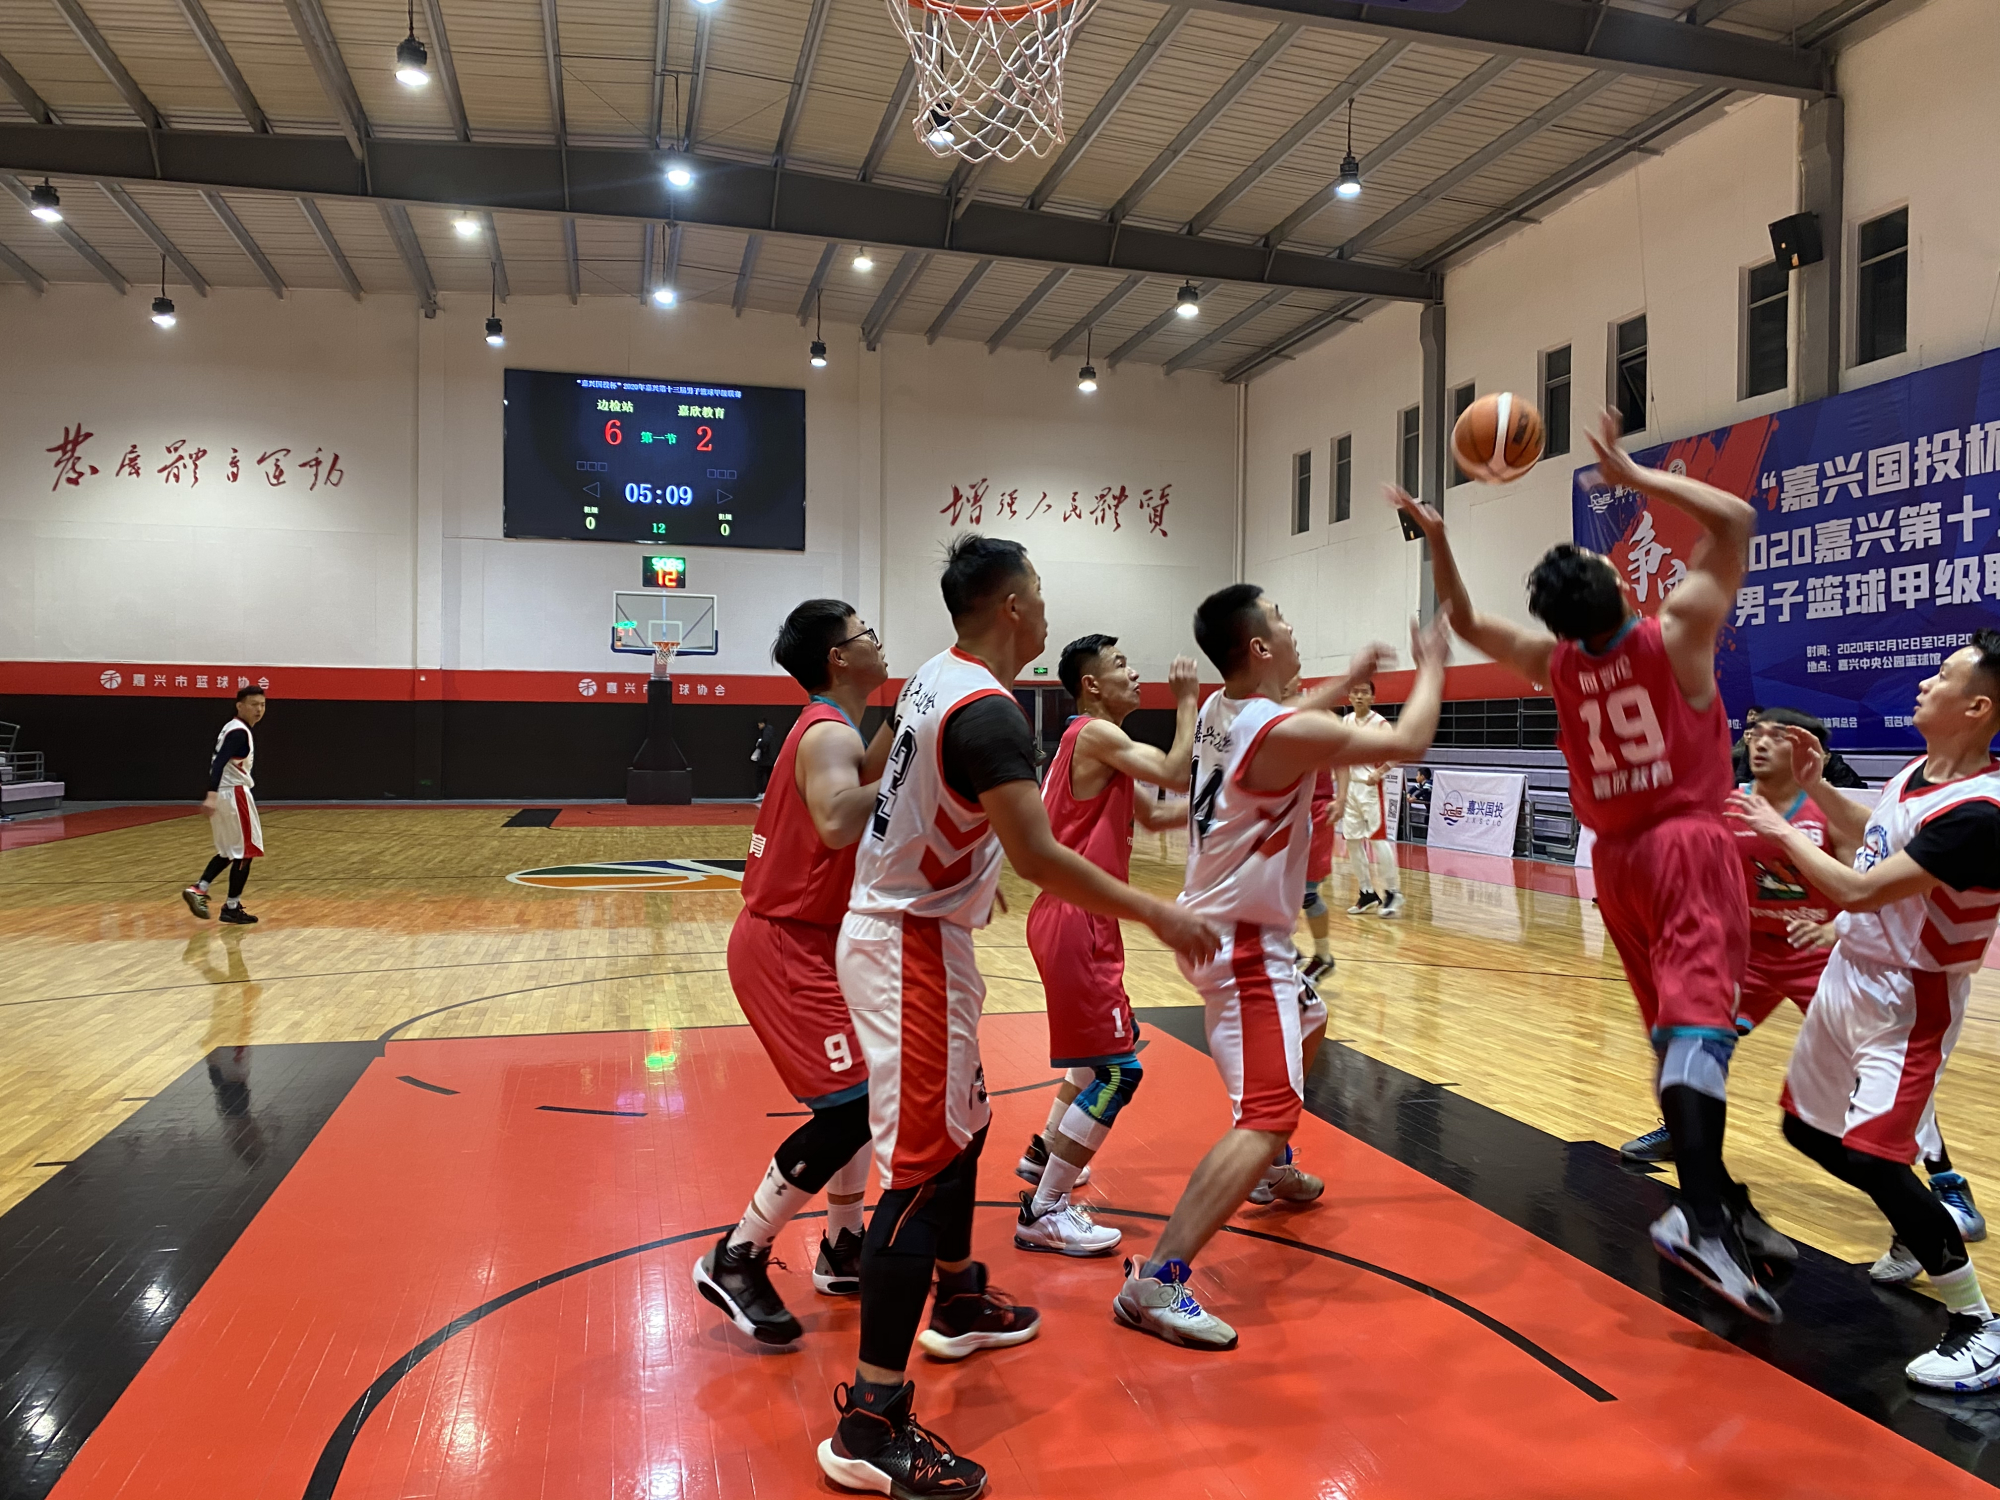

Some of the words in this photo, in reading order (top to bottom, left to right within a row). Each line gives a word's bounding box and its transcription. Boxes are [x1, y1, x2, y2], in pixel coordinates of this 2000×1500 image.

[597, 399, 634, 413] 边检站
[678, 404, 726, 420] 嘉欣教育
[604, 419, 622, 445] 6
[640, 431, 677, 445] 第一节
[696, 425, 713, 451] 2
[625, 482, 693, 506] 05:09
[585, 516, 596, 530] 0
[652, 523, 666, 534] 12
[720, 523, 731, 536] 0
[1748, 494, 2000, 572] 020嘉兴第十
[657, 569, 677, 587] 12
[132, 673, 270, 690] 嘉兴市篮球协会
[1578, 684, 1666, 773] 19
[1466, 799, 1504, 819] 嘉兴国投
[1111, 1007, 1126, 1039] 1
[824, 1033, 853, 1073] 9
